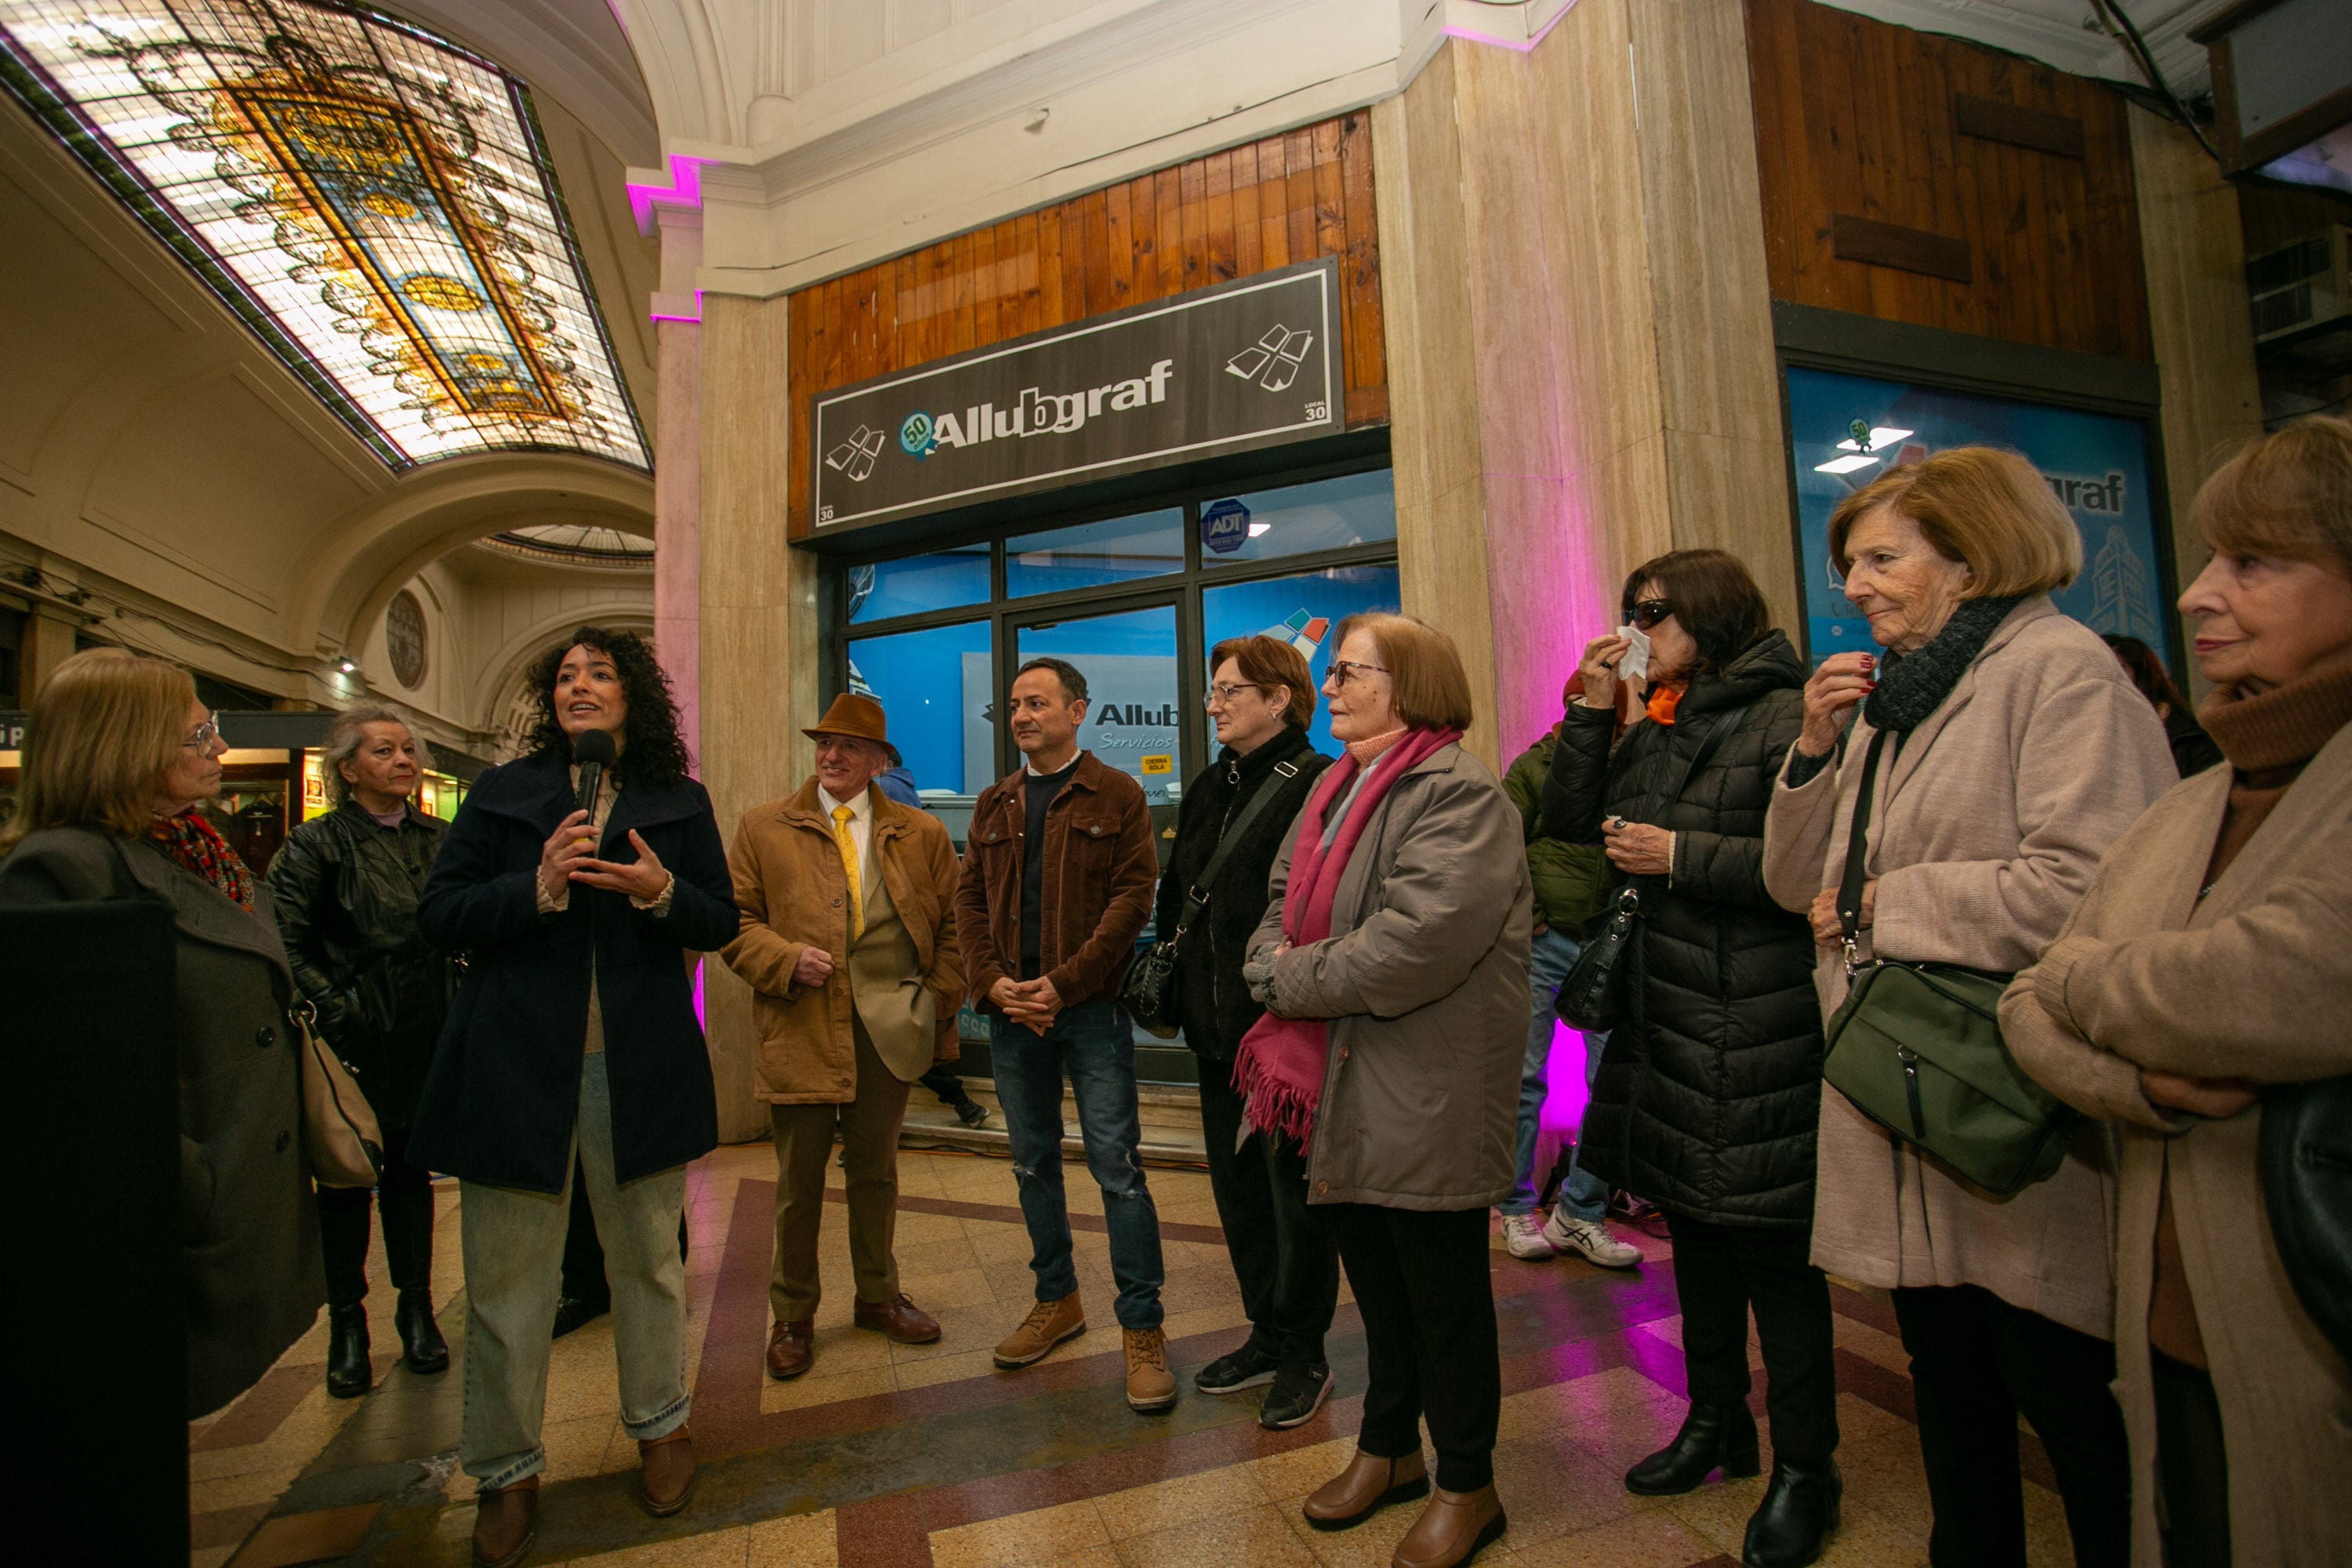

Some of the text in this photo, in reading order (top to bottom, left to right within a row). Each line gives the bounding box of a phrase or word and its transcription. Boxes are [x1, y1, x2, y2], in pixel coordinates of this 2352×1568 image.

[925, 359, 1173, 456] Allubgraf
[1305, 400, 1325, 408] LOCAL
[1305, 406, 1326, 421] 30
[904, 416, 927, 445] 50
[820, 510, 834, 521] 30
[1209, 512, 1243, 536] ADT
[1100, 732, 1173, 750] Servicios
